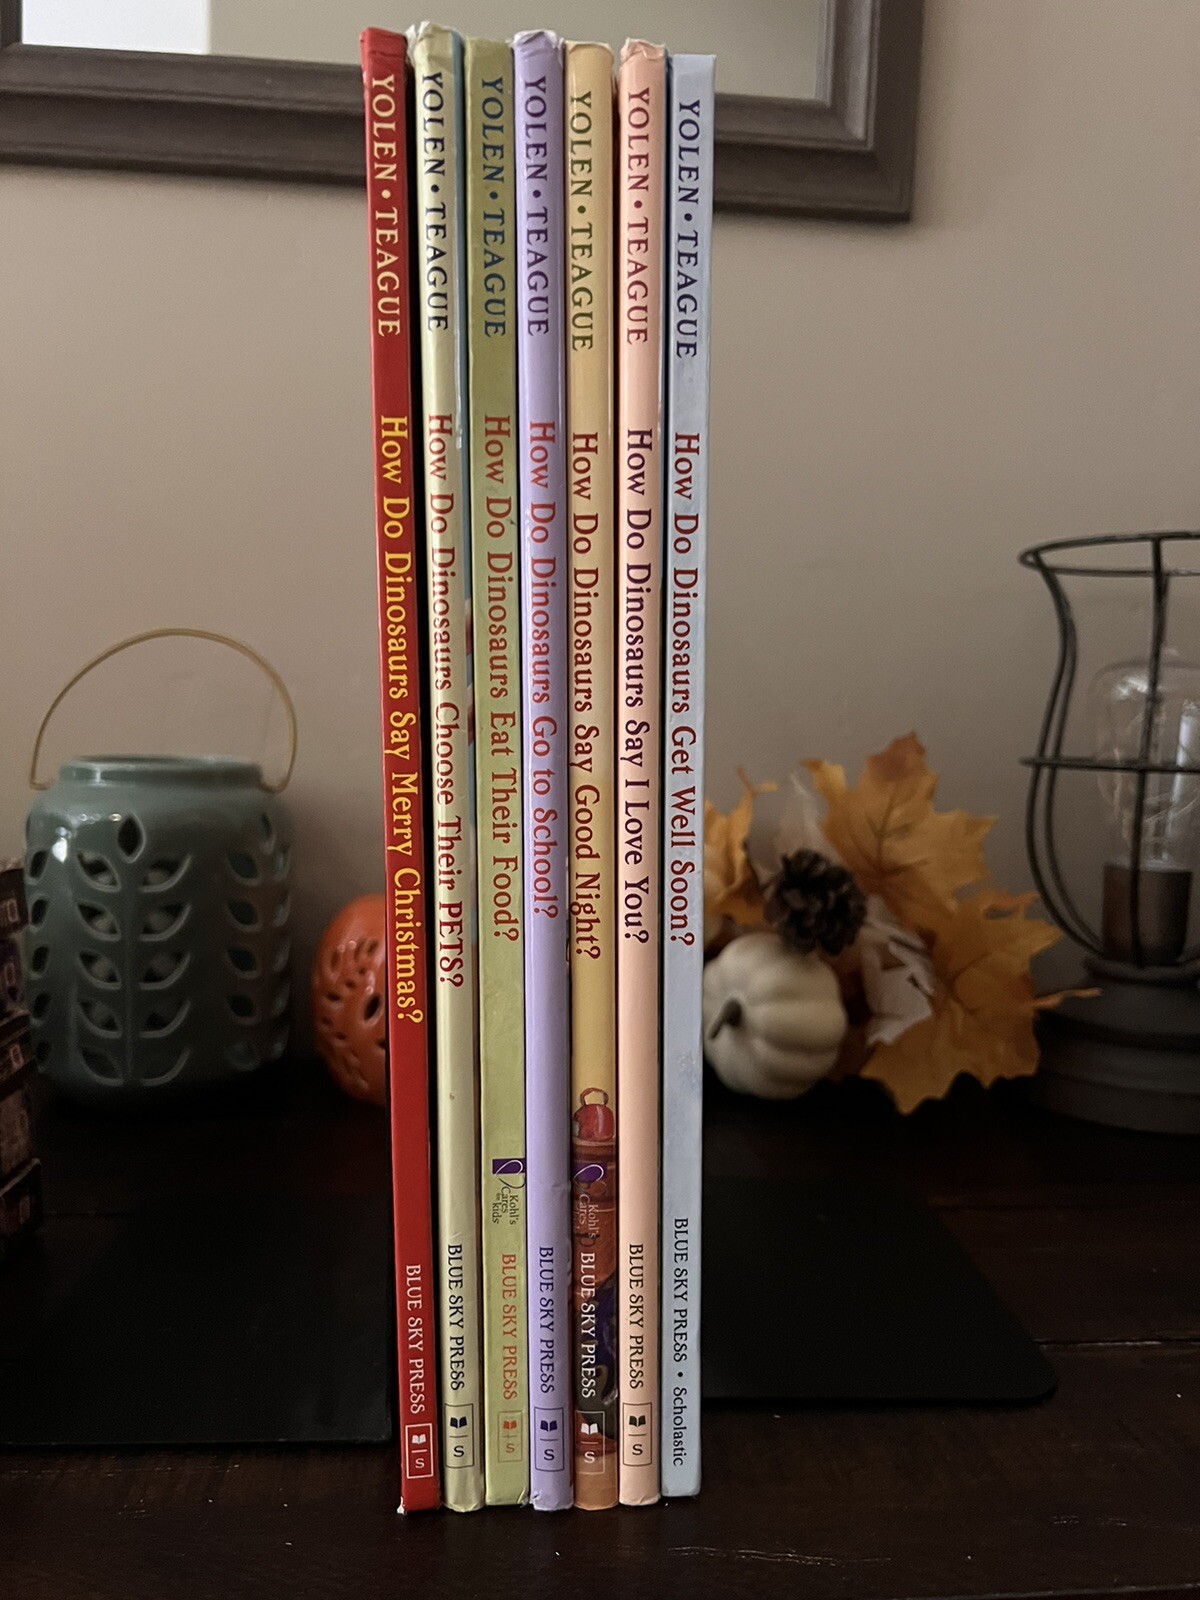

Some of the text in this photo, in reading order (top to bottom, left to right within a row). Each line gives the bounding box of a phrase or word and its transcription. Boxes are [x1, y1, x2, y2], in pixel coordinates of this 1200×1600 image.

[372, 74, 401, 337] YOLEN TEAGUE
[421, 72, 449, 331] YOLEN TEAGUE
[481, 77, 506, 338] YOLEN TEAGUE
[525, 76, 550, 335] YOLEN TEAGUE
[570, 92, 593, 351] YOLEN TEAGUE
[627, 87, 650, 343] YOLEN TEAGUE
[676, 100, 700, 358] YOLEN TEAGUE
[381, 415, 423, 1024] How Do Dinosaurs Say Merry Christmas?
[428, 414, 464, 988] How Do Dinosaurs Choose Their PETS?
[485, 415, 519, 942] How Do Dinosaurs Eat Their Food?
[530, 421, 558, 919] How Do Dinosaurs Go to School?
[570, 432, 601, 960] How Do Dinosaurs Say Good Night?
[620, 428, 652, 944] How Do Dinosaurs Say I Love You?
[670, 433, 700, 947] How Do Dinosaurs Get Well Soon?
[492, 1202, 503, 1225] kids
[501, 1186, 511, 1214] Cares
[509, 1194, 520, 1225] Kohl's
[588, 1204, 600, 1239] Kohl's
[406, 1264, 425, 1414] BLUE SKY PRESS
[448, 1244, 465, 1391] BLUE SKY PRESS
[501, 1253, 518, 1400] BLUE SKY PRESS
[539, 1247, 555, 1394] BLUE SKY PRESS
[580, 1252, 596, 1398] BLUE SKY PRESS
[629, 1244, 645, 1389] BLUE SKY PRESS
[672, 1218, 689, 1467] BLUE SKY PRESS Scholastic
[415, 1458, 424, 1469] S
[453, 1445, 465, 1458] S
[505, 1443, 515, 1454] S
[544, 1448, 555, 1461] S
[584, 1451, 596, 1464] S
[632, 1443, 643, 1456] S
